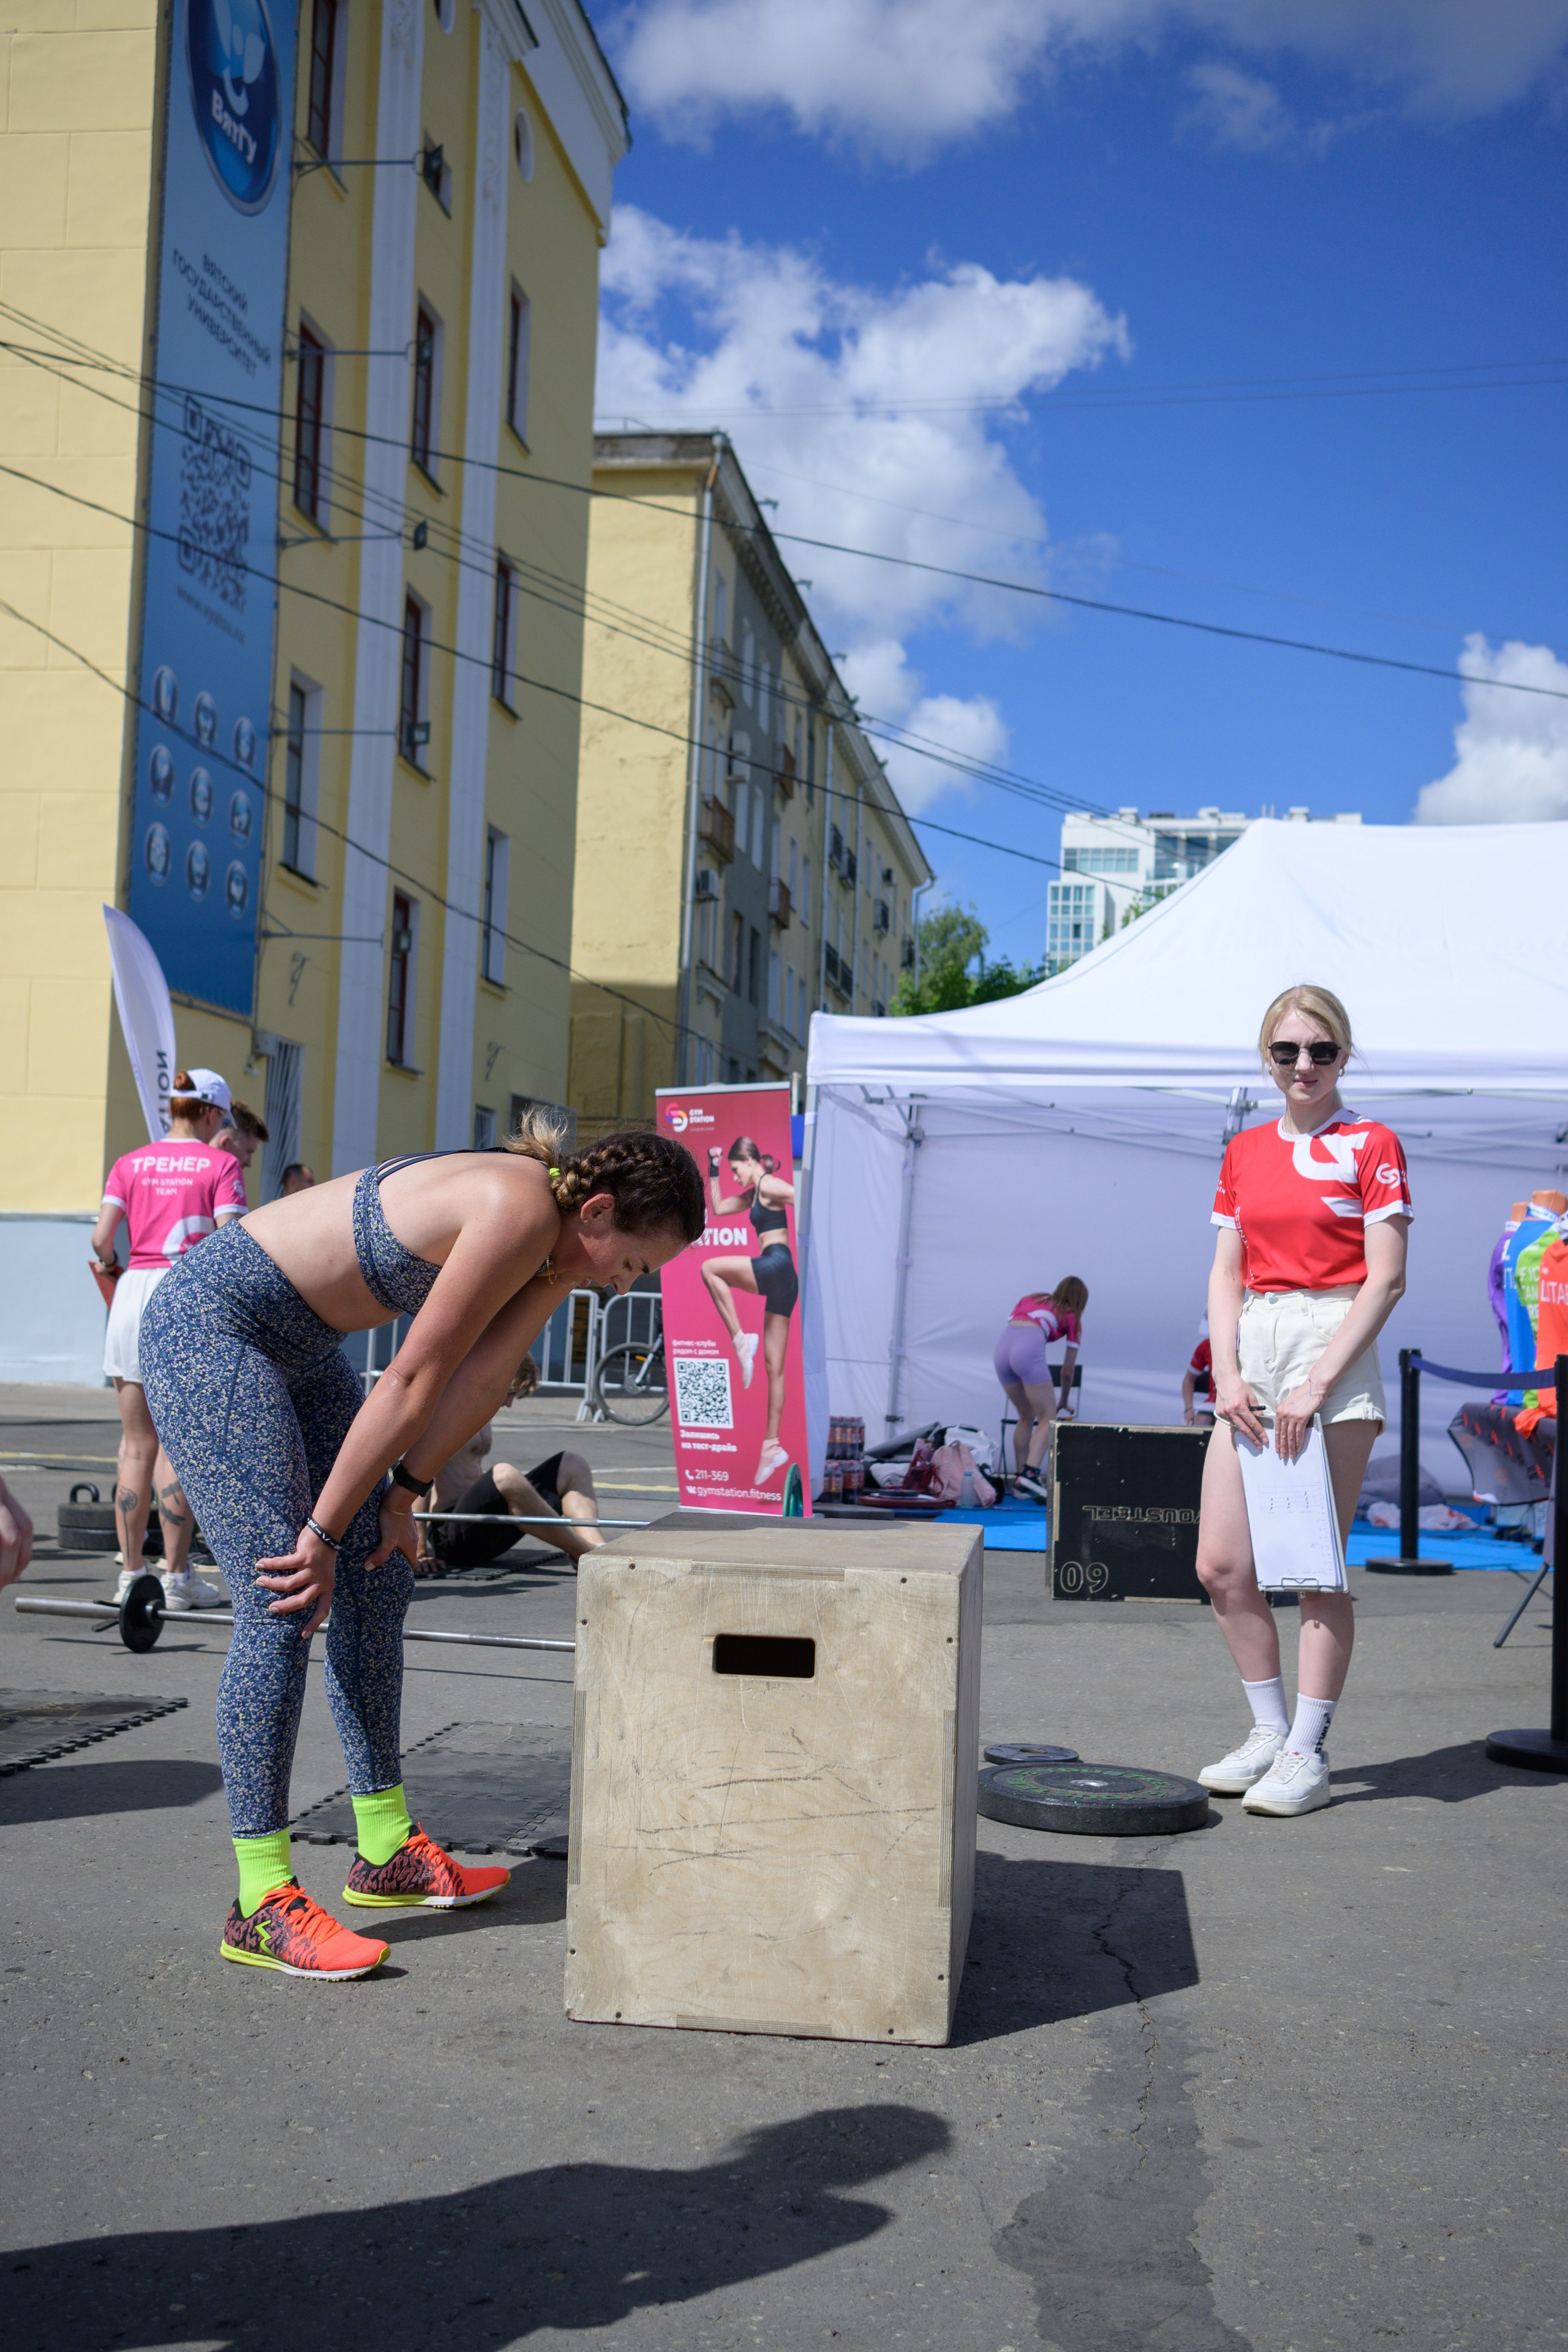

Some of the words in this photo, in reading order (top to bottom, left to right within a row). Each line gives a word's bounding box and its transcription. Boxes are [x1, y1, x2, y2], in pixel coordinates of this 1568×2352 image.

[689, 1115, 715, 1124] STATION
[132, 1156, 211, 1173] ТРЕНЕР
[160, 1178, 194, 1186] STATION
[155, 1187, 177, 1196] TEAM
[1235, 1205, 1249, 1249] TNESS
[695, 1469, 729, 1481] 211-369
[697, 1486, 782, 1501] gymstation.fitness
